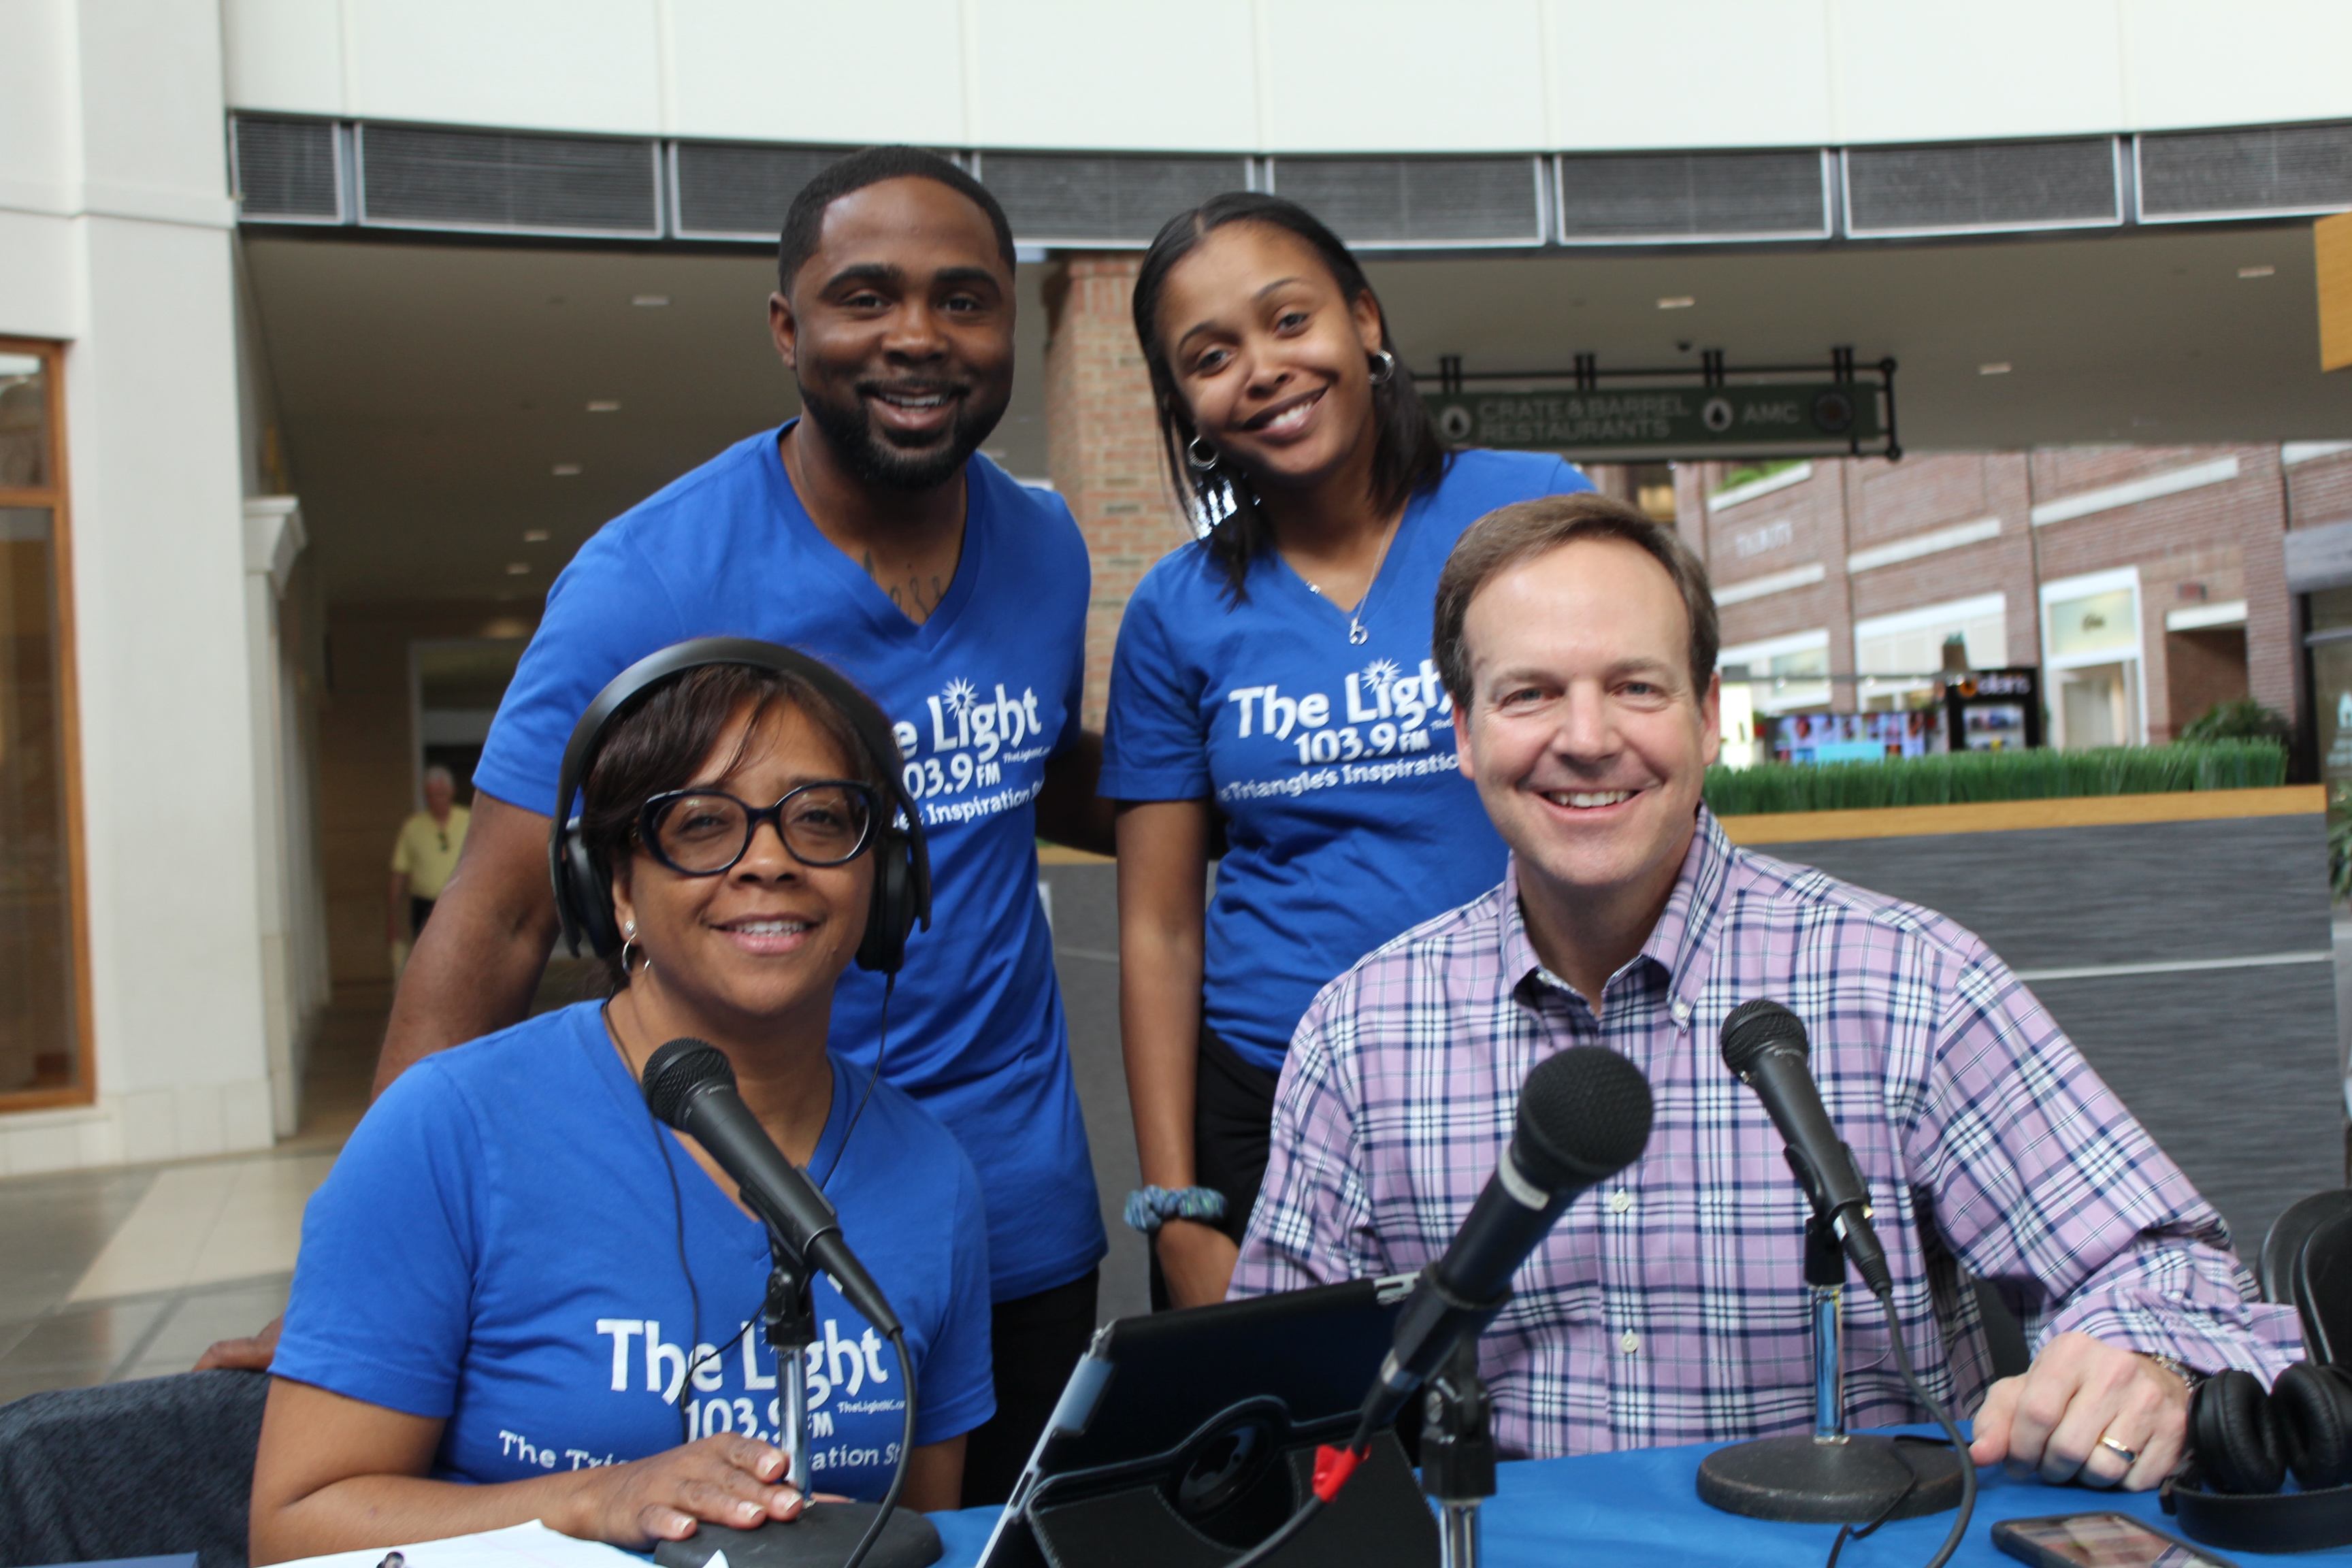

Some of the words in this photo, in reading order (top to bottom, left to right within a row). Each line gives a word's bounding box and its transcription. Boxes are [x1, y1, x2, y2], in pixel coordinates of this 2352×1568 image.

[1477, 418, 1671, 442] RESTAURANTS
[1742, 404, 1800, 425] AMC
[927, 676, 1042, 764] Light
[1228, 685, 1330, 742] The
[1345, 658, 1453, 732] Ligh
[1294, 722, 1397, 766] 103.9
[1398, 728, 1431, 753] FM
[902, 753, 973, 801] 03.9
[976, 762, 1001, 788] FM
[1341, 751, 1460, 784] Inspiratio
[926, 787, 1030, 826] Inspiration
[596, 1319, 724, 1405] The
[740, 1319, 888, 1411] Lght
[499, 1429, 557, 1469] The
